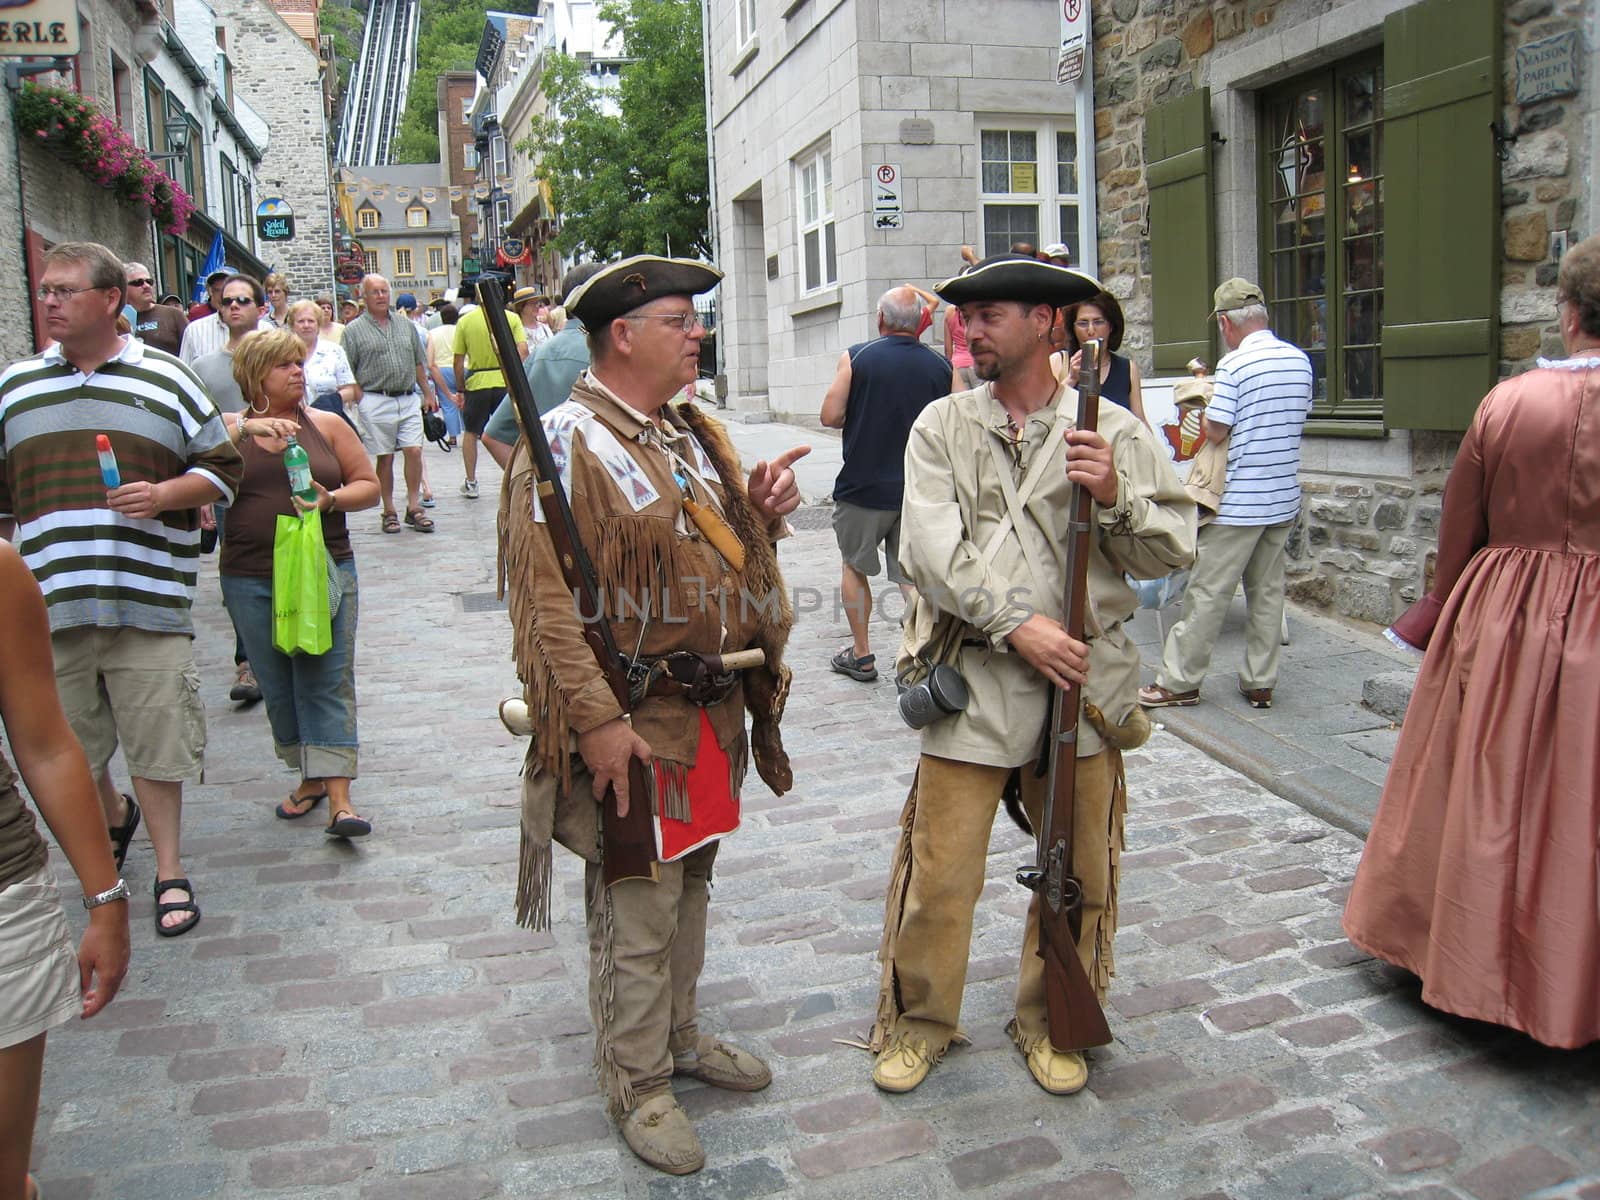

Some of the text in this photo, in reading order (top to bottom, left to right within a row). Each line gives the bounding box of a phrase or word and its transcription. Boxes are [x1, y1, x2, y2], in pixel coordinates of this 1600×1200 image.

[1523, 45, 1569, 65] MAISON
[1523, 62, 1569, 83] PARENT
[266, 219, 285, 228] Soleil
